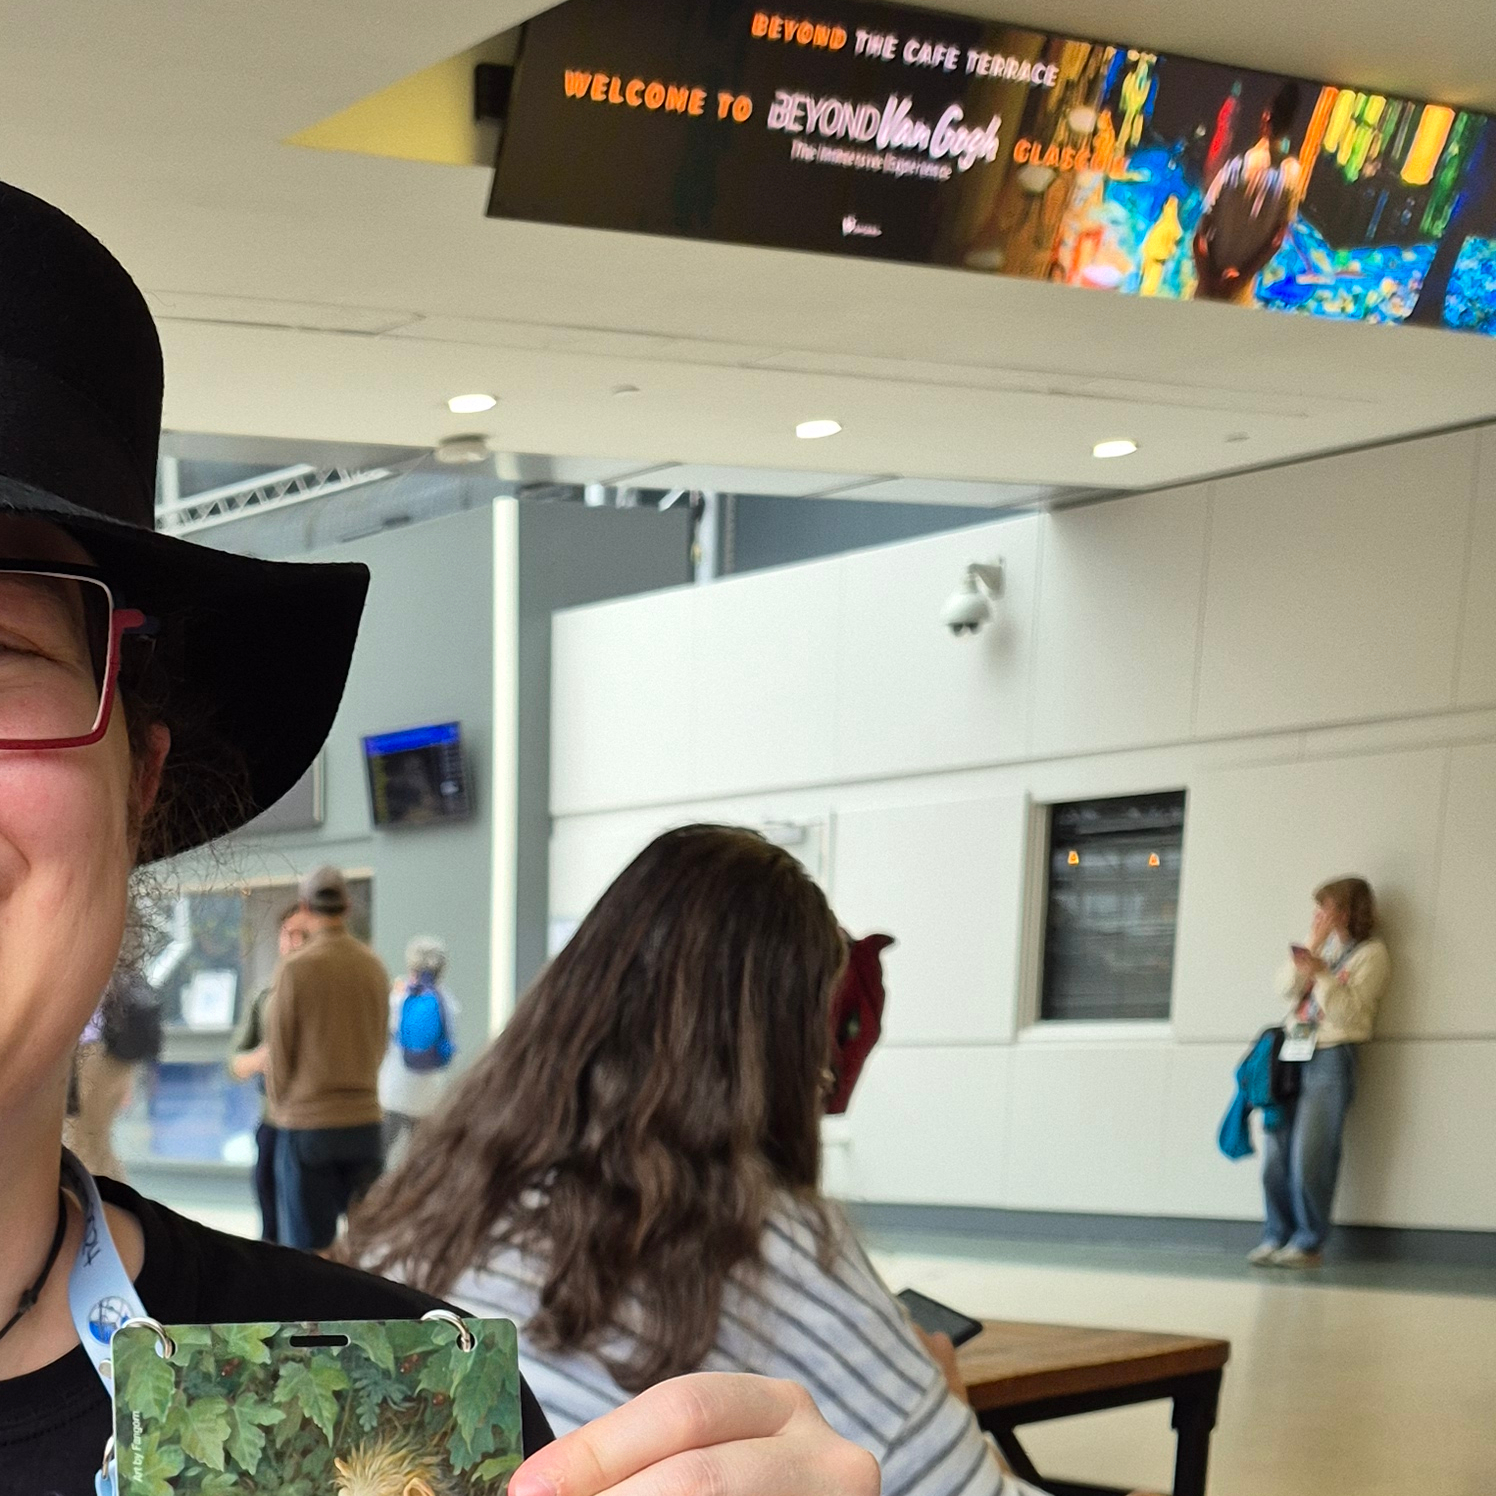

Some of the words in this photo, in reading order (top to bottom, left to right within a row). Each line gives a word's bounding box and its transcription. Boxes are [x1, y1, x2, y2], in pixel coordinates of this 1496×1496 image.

[751, 12, 847, 50] BEYOND
[855, 28, 899, 60] THE
[903, 40, 960, 71] CAFE
[966, 51, 1059, 87] TERRACE
[564, 70, 706, 115] WELCOME
[717, 92, 753, 122] TO
[767, 92, 880, 141] BEYOND
[875, 95, 931, 151] Van
[929, 104, 1002, 172] Gogh
